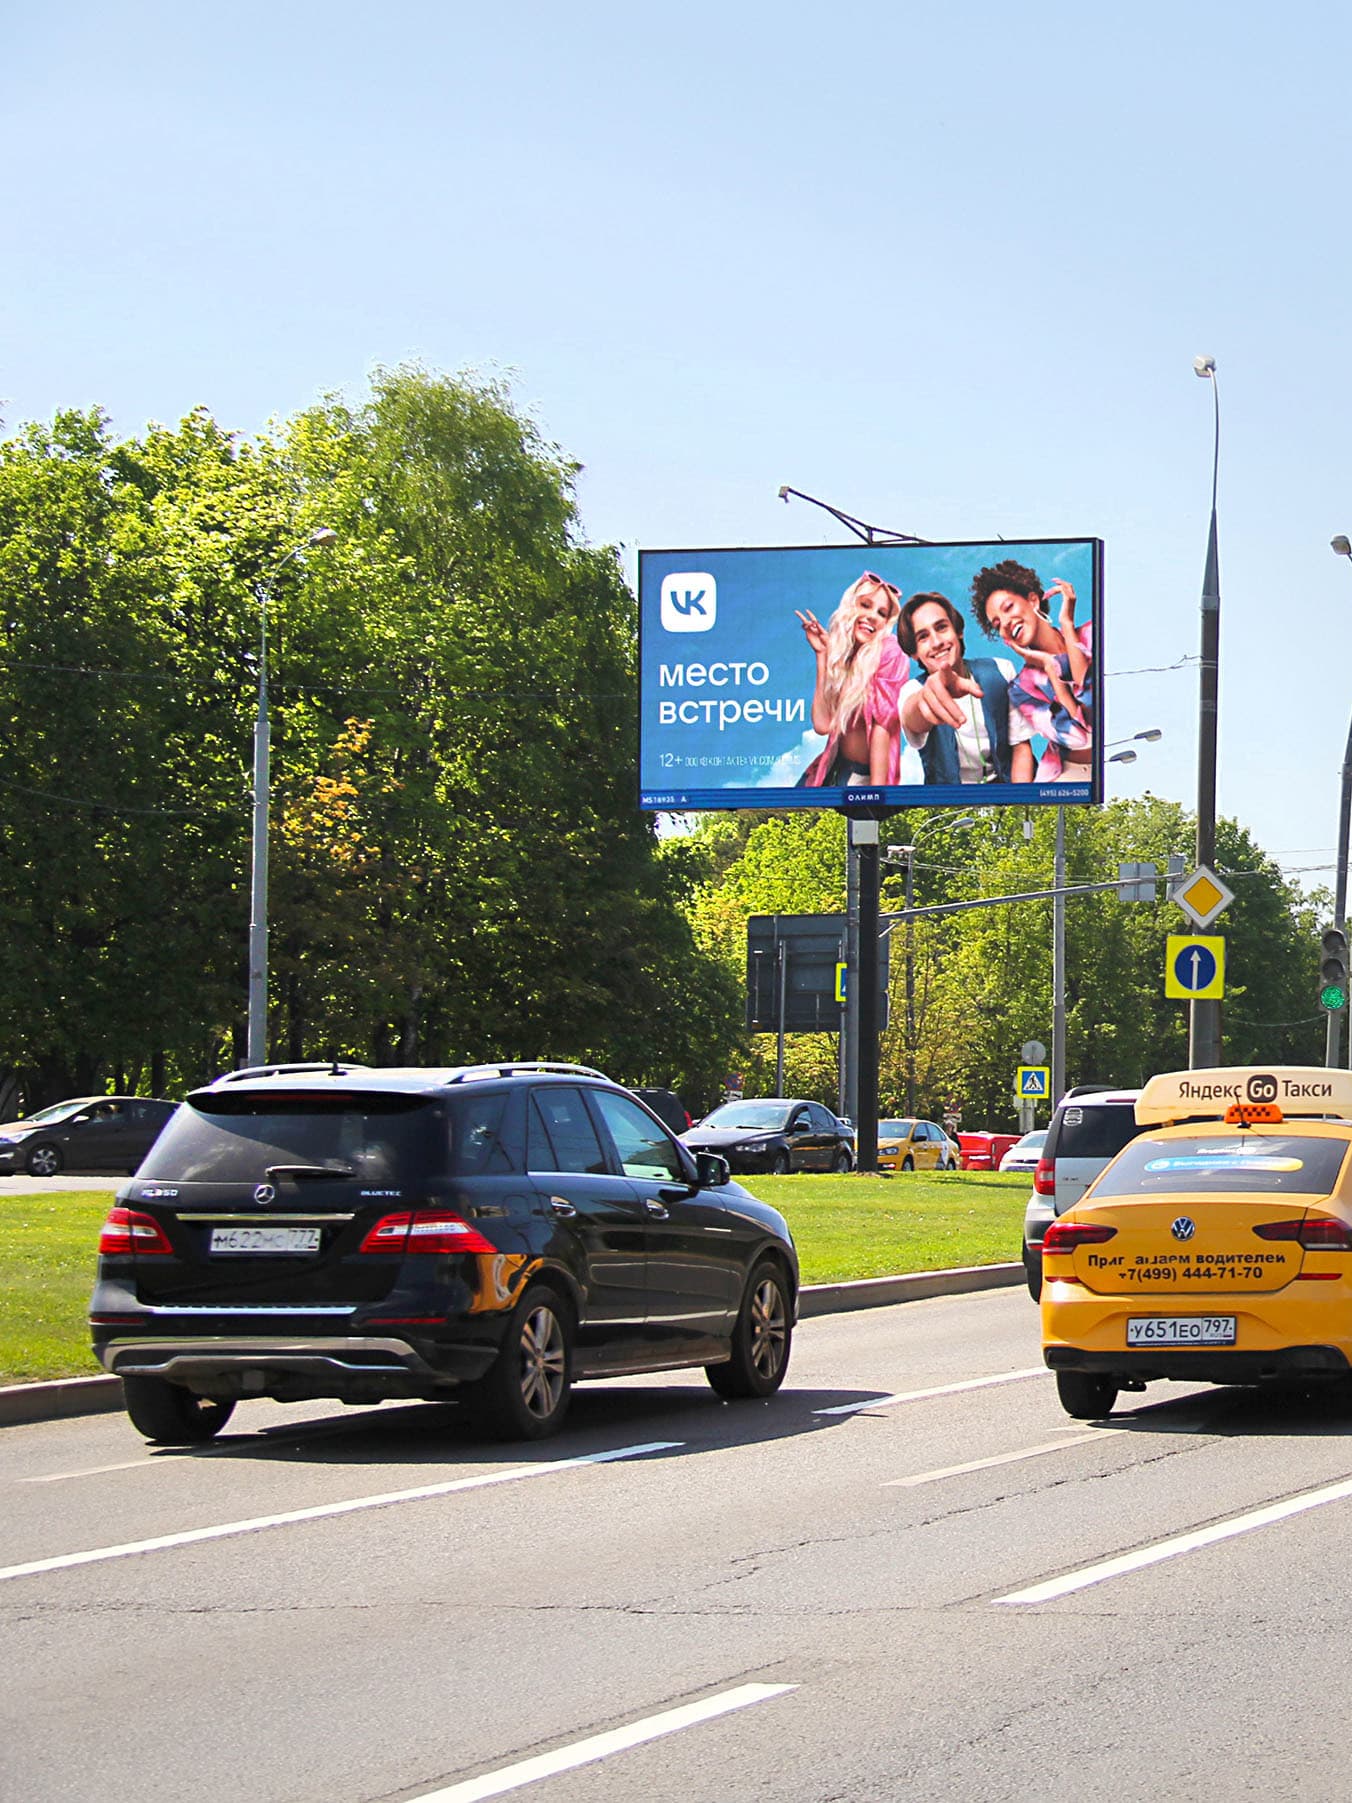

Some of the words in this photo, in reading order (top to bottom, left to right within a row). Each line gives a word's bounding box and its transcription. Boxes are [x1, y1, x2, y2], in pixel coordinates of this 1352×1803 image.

[670, 589, 707, 616] VK
[659, 661, 770, 688] место
[659, 698, 806, 731] встречи
[660, 752, 683, 768] 12+
[1179, 1081, 1242, 1100] Яндекс
[1249, 1080, 1275, 1098] Go
[1282, 1080, 1333, 1097] Такси
[1118, 1267, 1177, 1283] +7(499)
[1182, 1266, 1263, 1279] 444-71-70
[1203, 1319, 1230, 1333] 797
